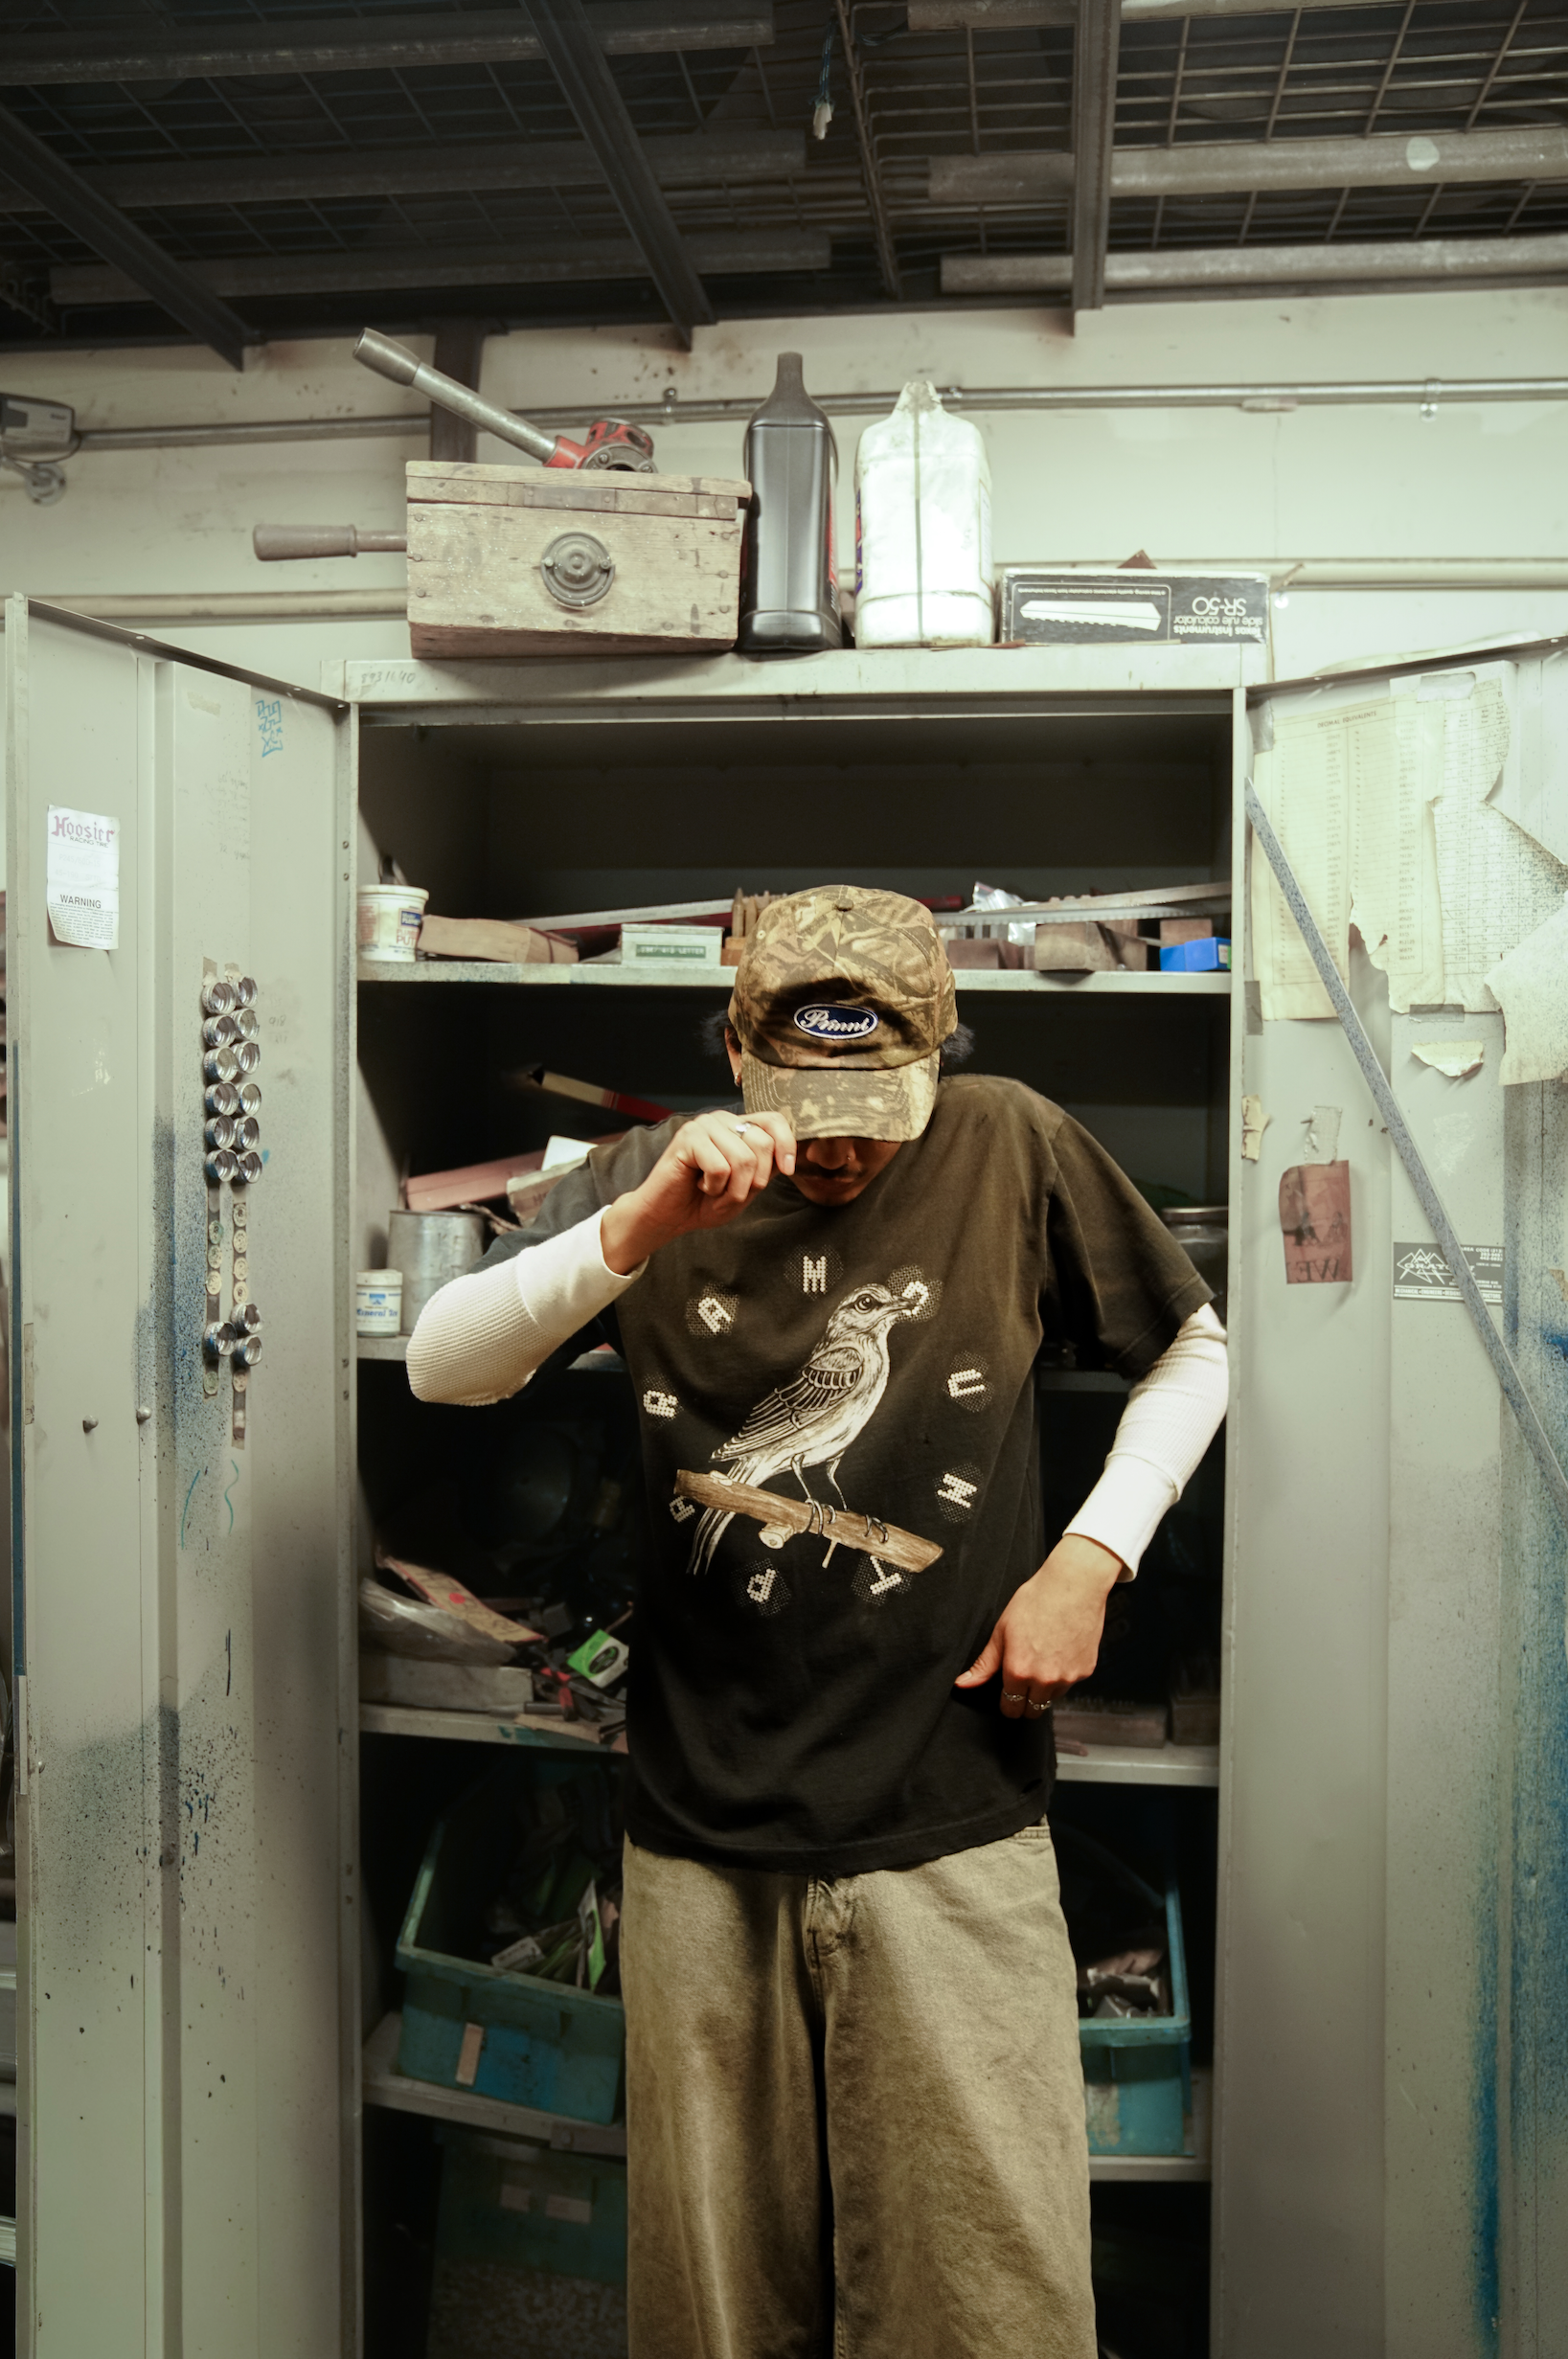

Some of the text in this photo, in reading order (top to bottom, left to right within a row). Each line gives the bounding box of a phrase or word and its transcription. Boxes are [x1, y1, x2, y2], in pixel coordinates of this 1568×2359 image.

[1192, 596, 1247, 616] SR-50
[1173, 615, 1263, 627] slide rule calculator
[1173, 624, 1262, 637] Texas Instruments
[1317, 710, 1377, 729] DECIMAL EQUIVALENTS
[51, 815, 115, 843] Hoosier
[70, 835, 94, 846] RACING
[59, 894, 102, 909] WARNING
